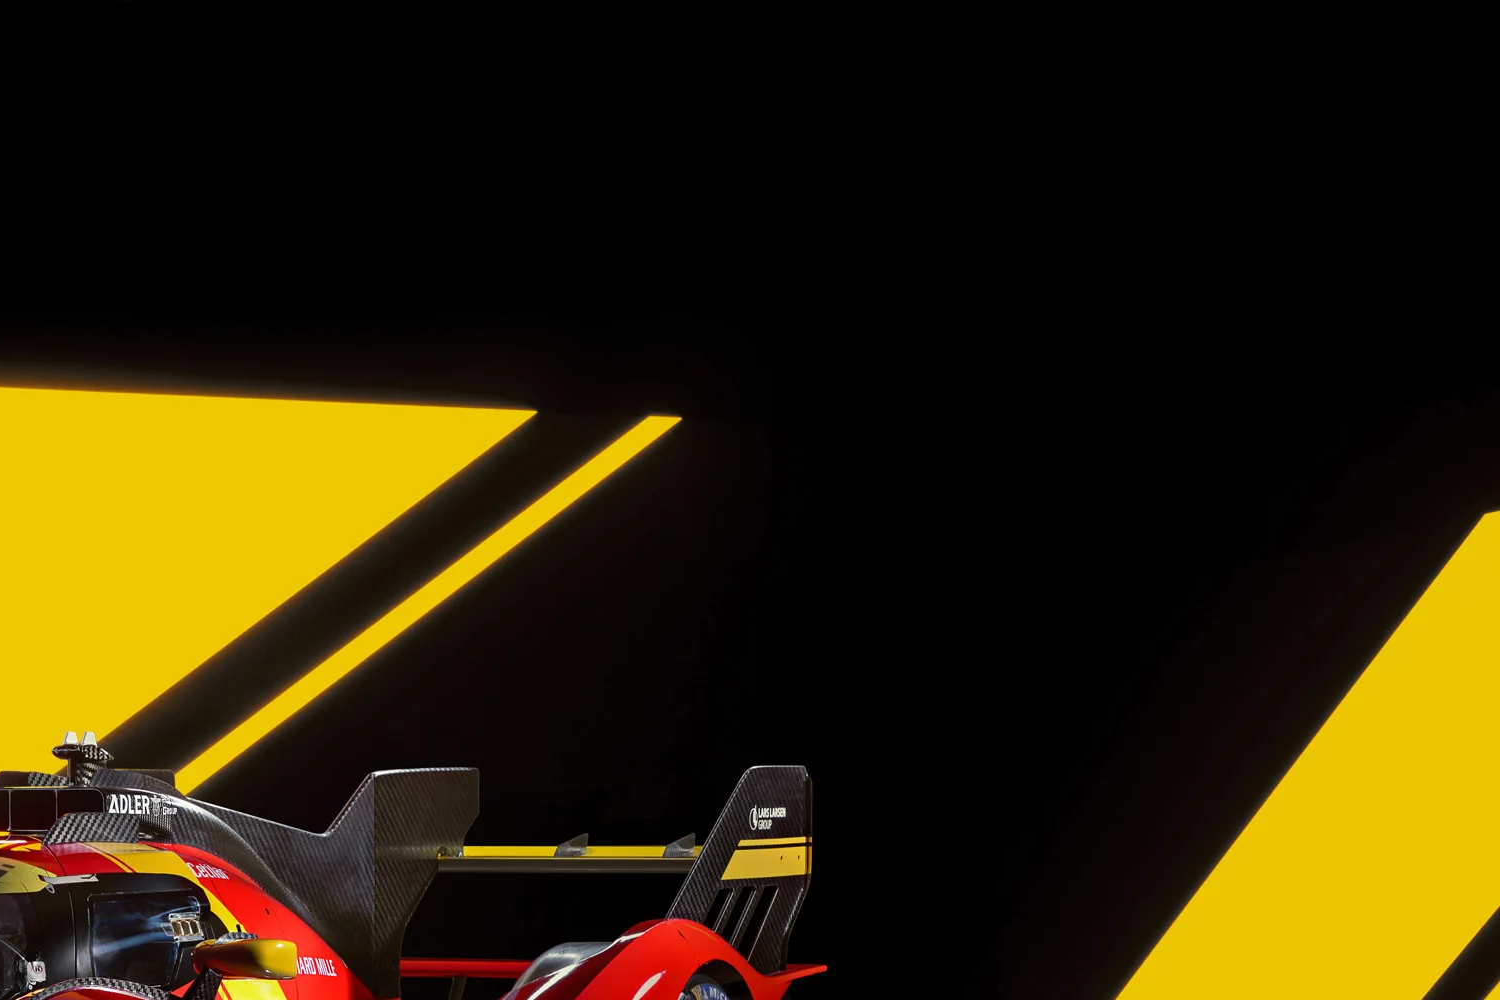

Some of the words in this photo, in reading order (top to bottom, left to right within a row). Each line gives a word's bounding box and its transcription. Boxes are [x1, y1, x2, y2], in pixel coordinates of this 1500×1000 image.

[108, 794, 150, 815] ADLER
[758, 807, 770, 818] LARS
[770, 807, 786, 818] LARSEN
[758, 819, 773, 830] GROUP
[315, 957, 338, 977] MILLE
